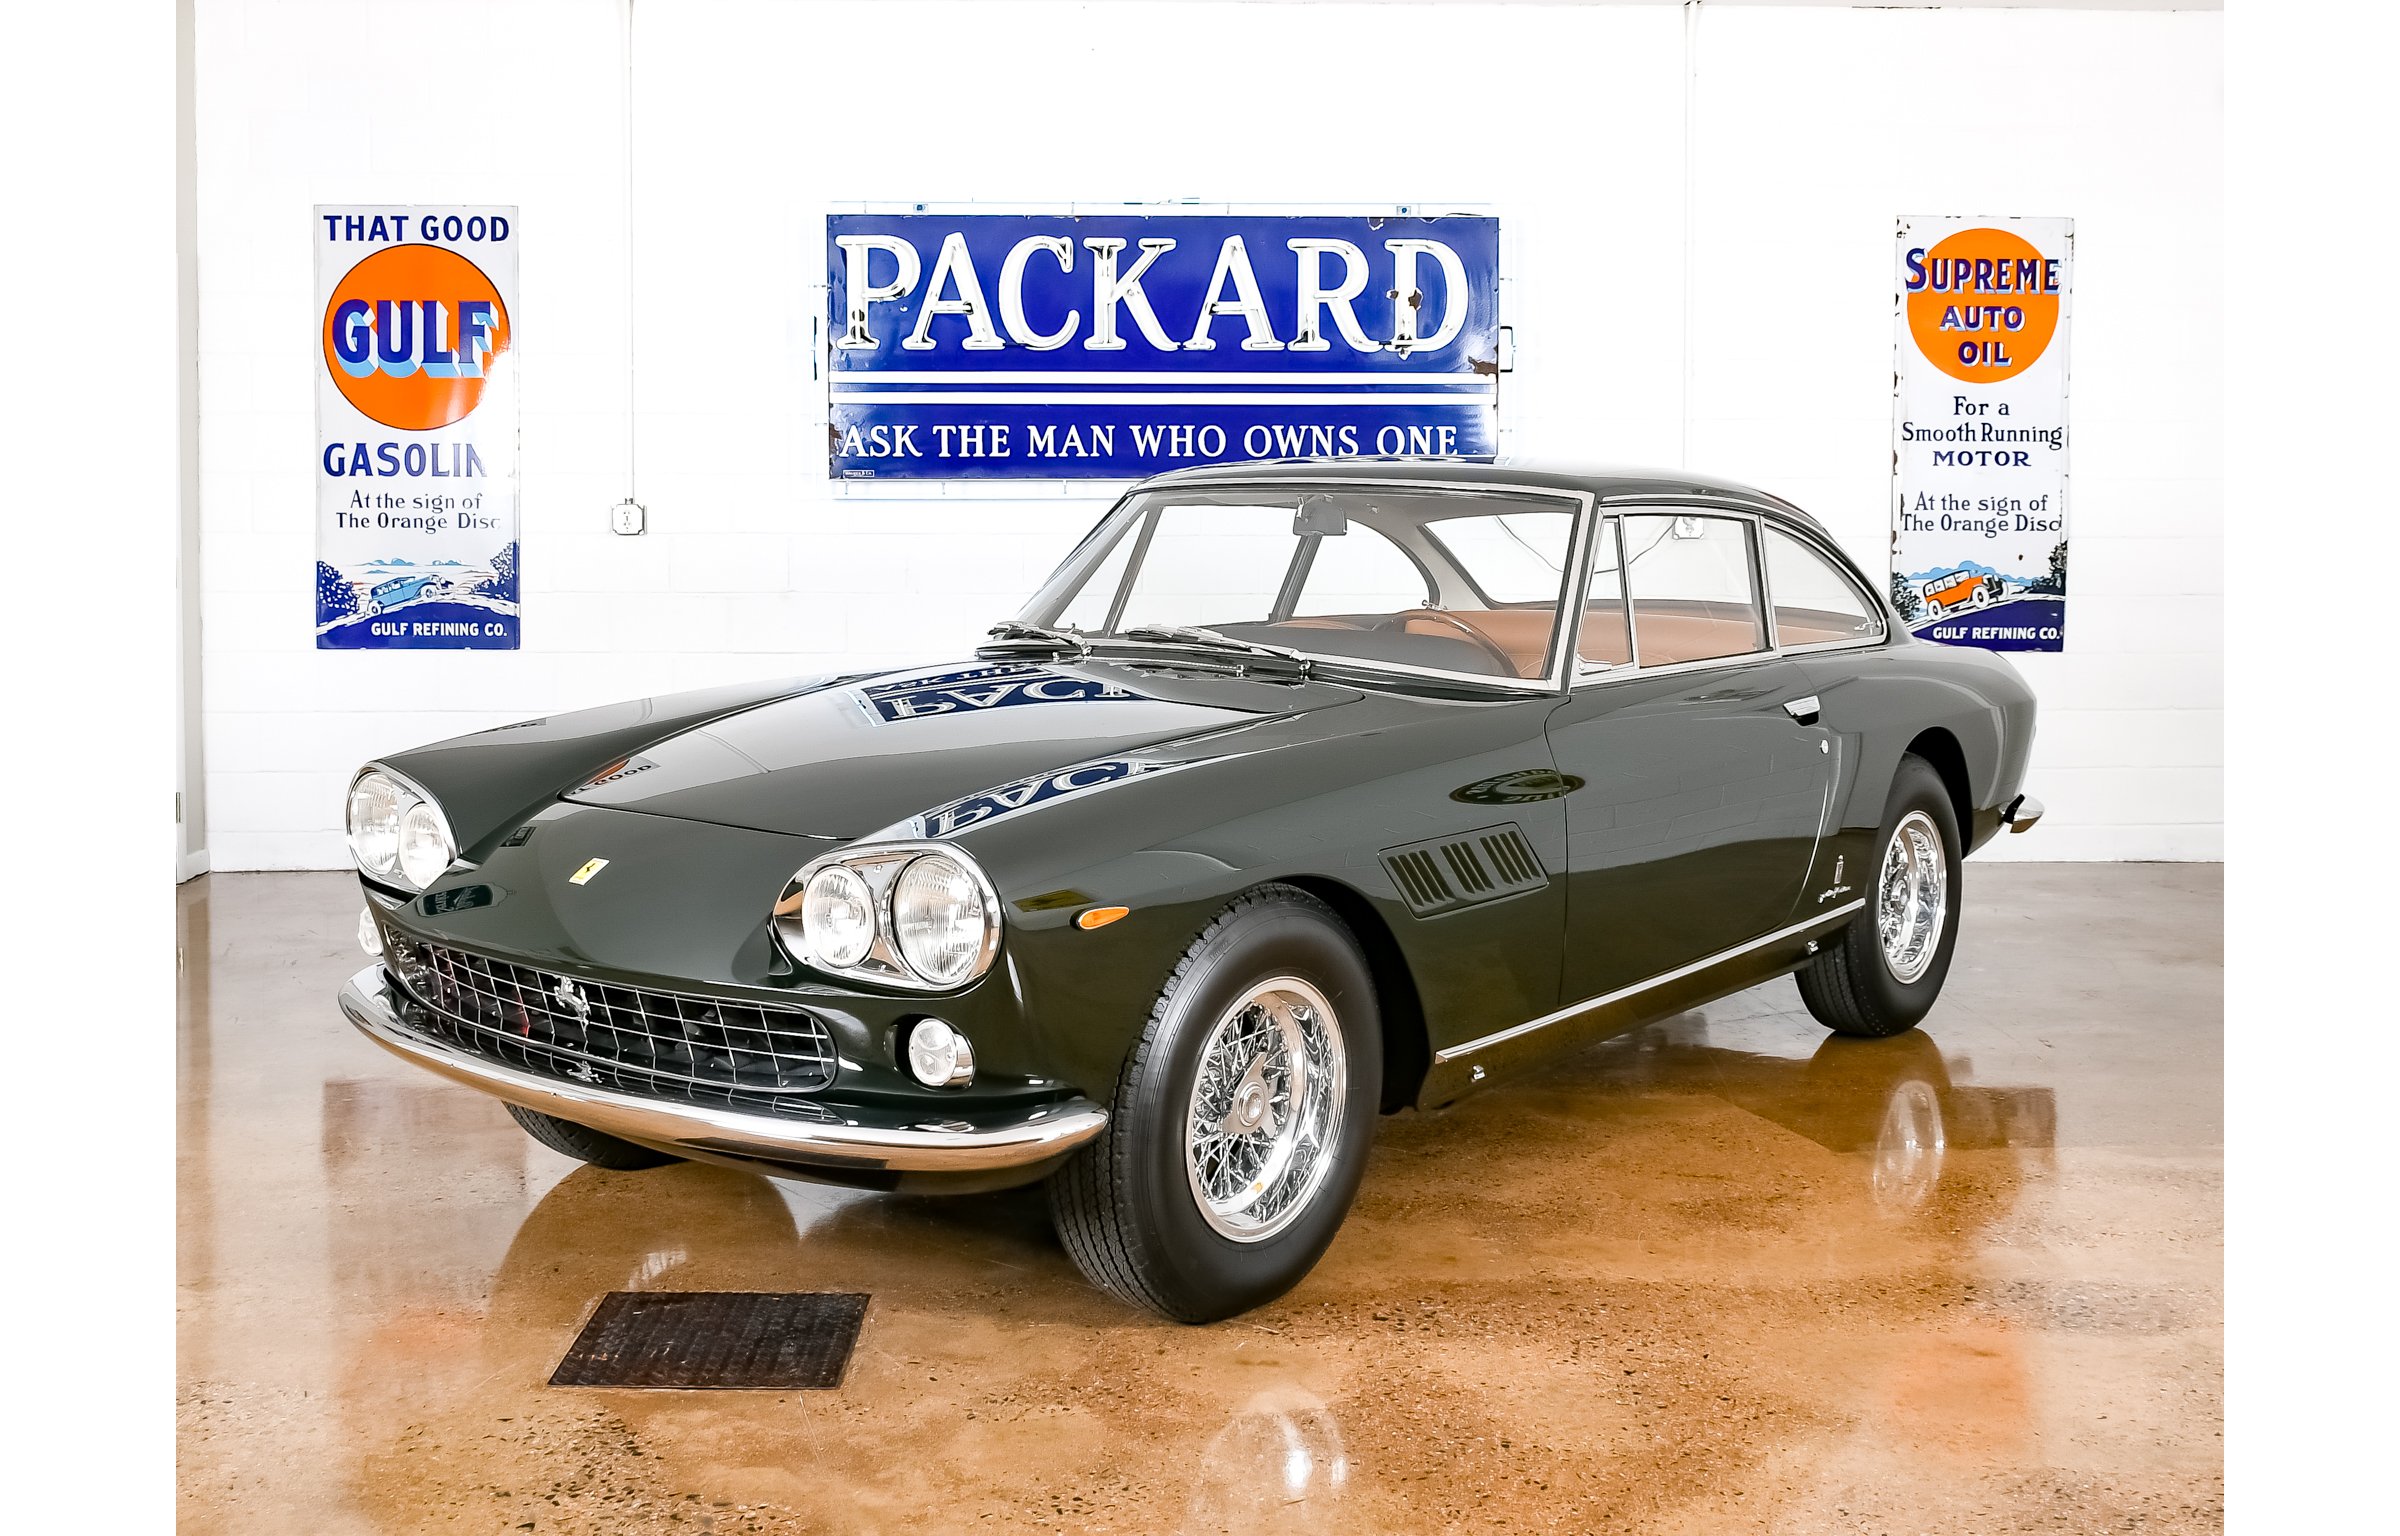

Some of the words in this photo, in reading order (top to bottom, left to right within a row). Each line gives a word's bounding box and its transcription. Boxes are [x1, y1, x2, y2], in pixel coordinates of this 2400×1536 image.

[323, 215, 409, 242] THAT
[421, 215, 510, 242] GOOD
[1905, 247, 2062, 294] SUPREME
[834, 231, 1471, 355] PACKARD
[1939, 305, 2026, 332] AUTO
[332, 298, 499, 378] GULF
[1958, 340, 2012, 367] OIL
[1953, 396, 1989, 416] For
[1998, 402, 2010, 416] a
[840, 424, 923, 458] ASK
[932, 424, 1011, 458] THE
[1026, 424, 1116, 458] MAN
[1129, 424, 1227, 458] WHO
[1243, 424, 1360, 457] OWNS
[1376, 425, 1459, 456] ONE
[1902, 421, 1976, 442] Smooth
[1981, 422, 2063, 450] Running
[323, 442, 487, 477] GASOLIN
[1932, 451, 2032, 467] MOTOR
[350, 489, 371, 509] At
[376, 492, 405, 509] the
[412, 493, 455, 514] sign
[462, 493, 483, 509] of
[1914, 491, 1935, 511] At
[1941, 494, 1970, 511] the
[1978, 495, 2021, 516] sign
[2029, 494, 2048, 511] of
[336, 512, 370, 529] The
[377, 512, 448, 534] Orange
[457, 512, 501, 529] Disc
[1902, 513, 1934, 531] The
[1941, 513, 2009, 538] Orange
[2014, 513, 2061, 532] Disc
[371, 622, 408, 637] GULF
[413, 622, 479, 637] REFINING
[484, 622, 508, 637] CO.
[1933, 626, 1968, 639] GULF
[1971, 626, 2036, 640] REFINING
[2039, 626, 2061, 640] CO.
